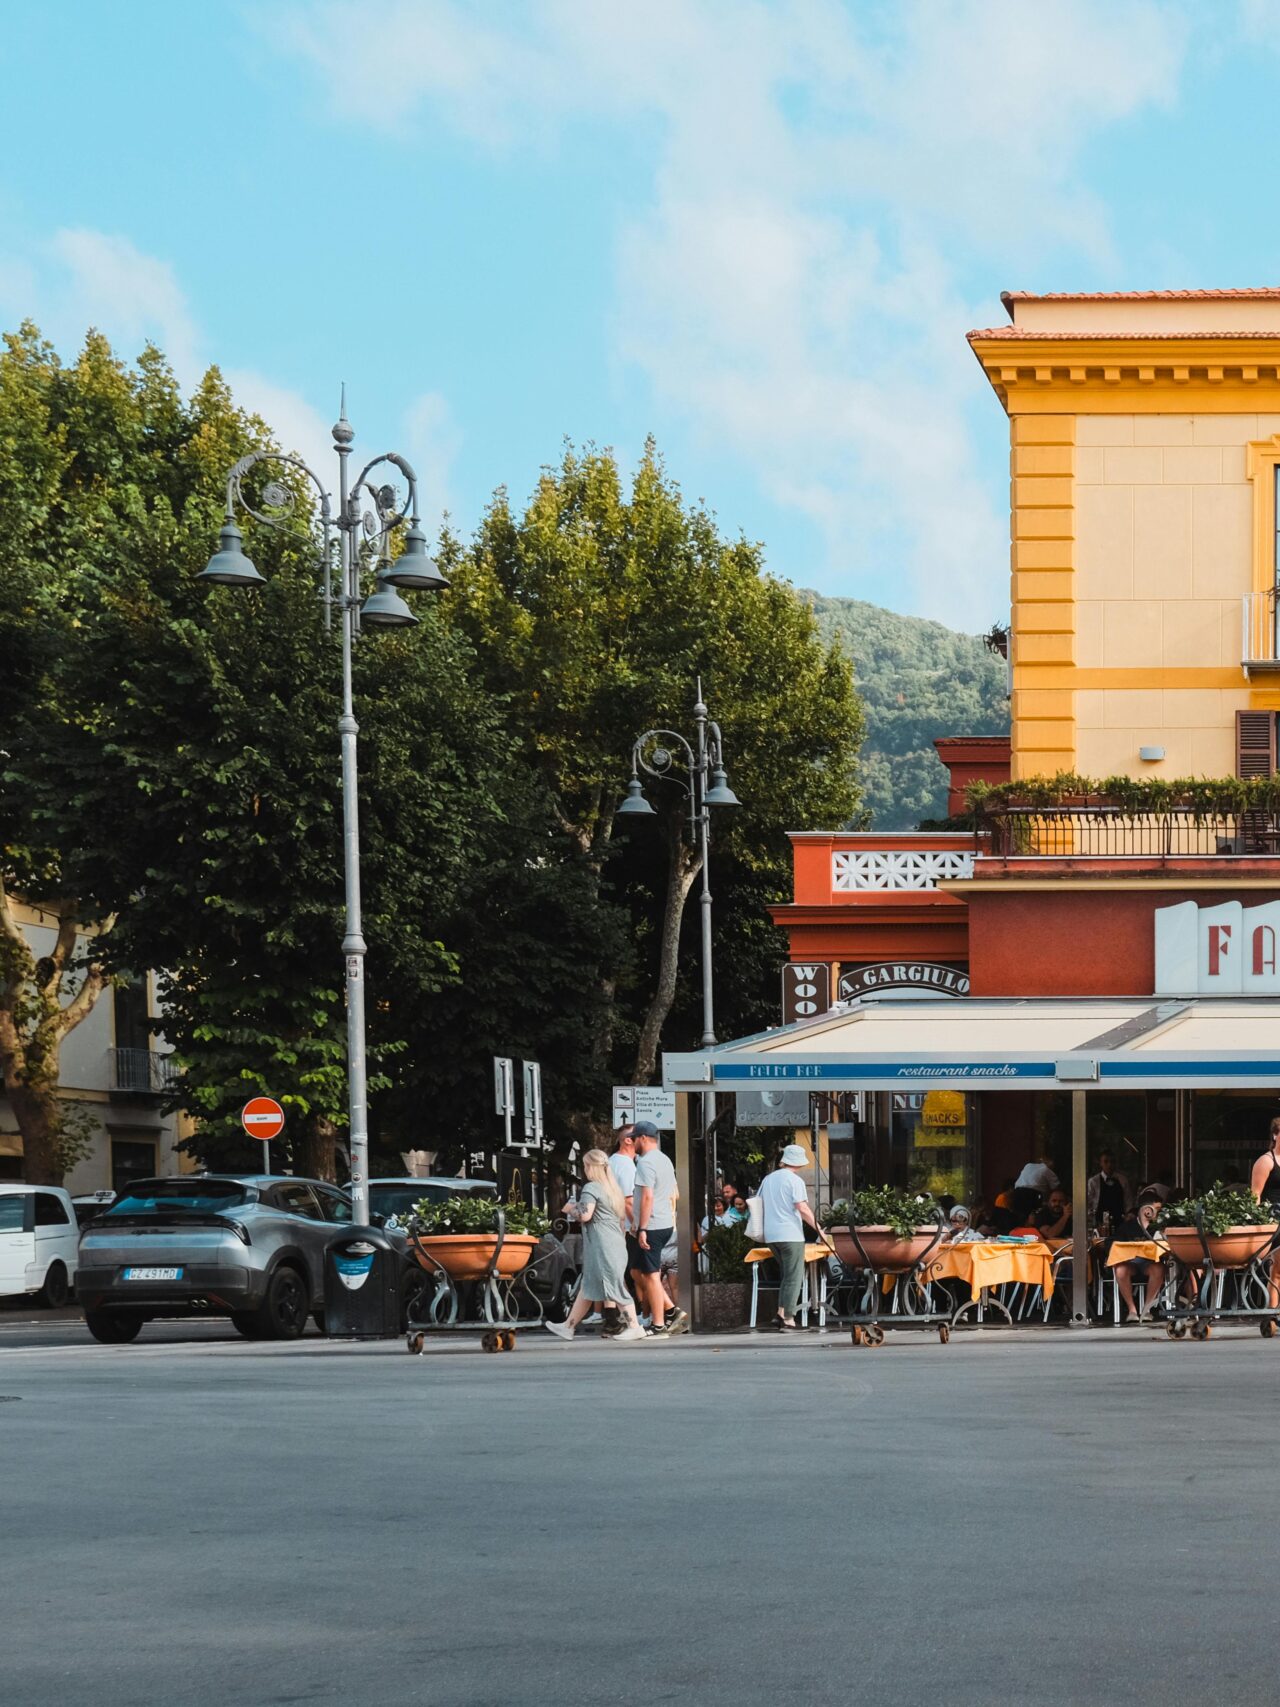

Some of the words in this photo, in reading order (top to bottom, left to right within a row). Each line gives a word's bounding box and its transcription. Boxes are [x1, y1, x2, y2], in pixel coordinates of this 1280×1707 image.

[791, 966, 819, 1022] WOO
[841, 979, 860, 996] A.
[863, 966, 970, 993] GARGIULO
[897, 1065, 969, 1075] restaurant
[970, 1064, 1018, 1075] snacks
